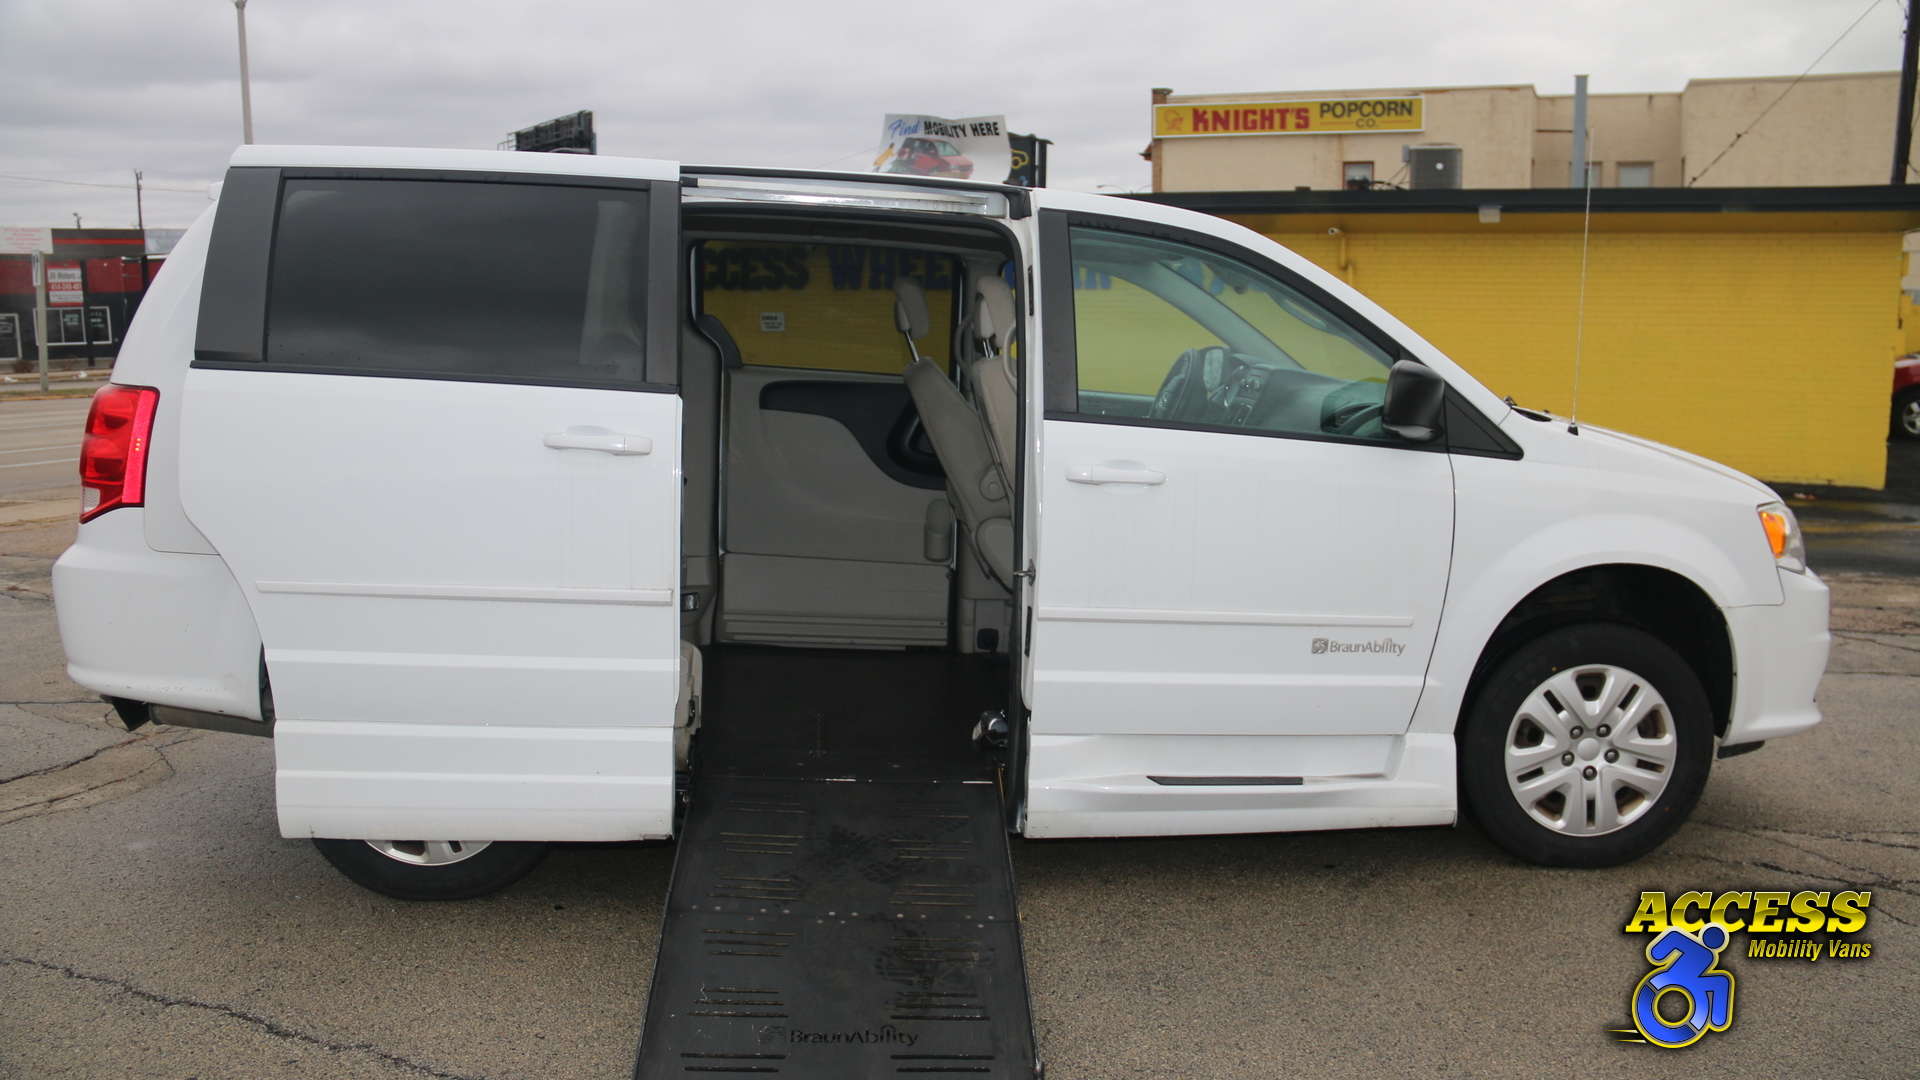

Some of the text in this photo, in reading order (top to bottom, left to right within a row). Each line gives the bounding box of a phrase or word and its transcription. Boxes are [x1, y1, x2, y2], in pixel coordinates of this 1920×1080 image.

[1192, 100, 1413, 132] KNIGHT'S POPCORN
[888, 119, 1000, 138] Find MOBILITY HERE
[1330, 637, 1406, 656] BraunAbility
[790, 1024, 918, 1046] BraunAbility
